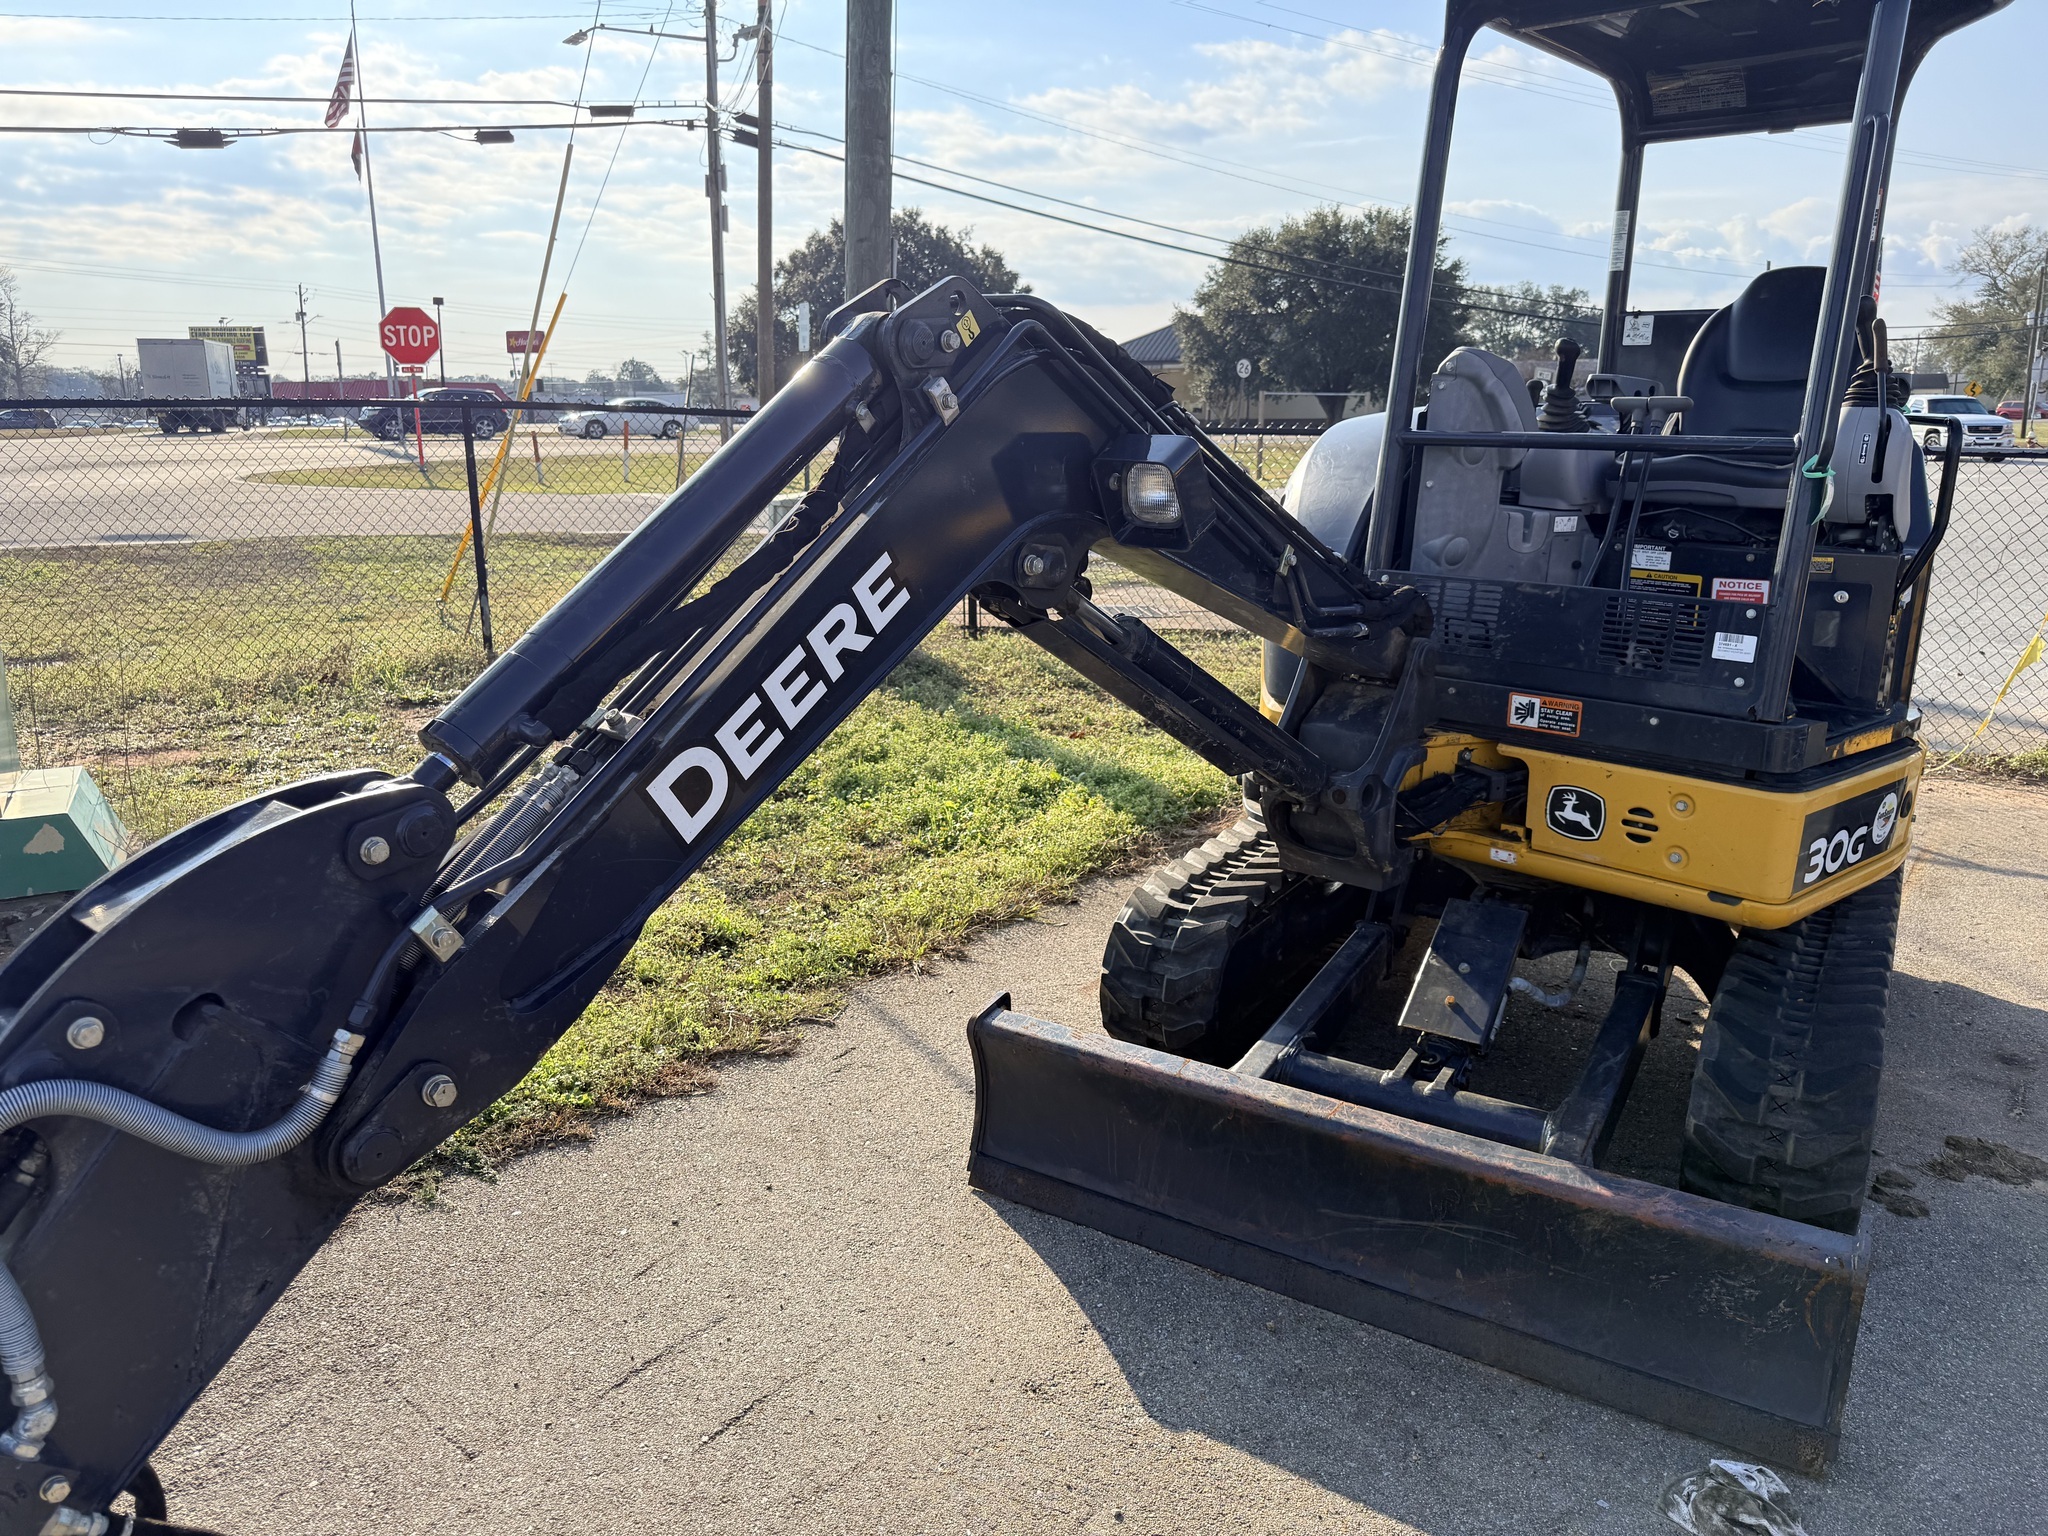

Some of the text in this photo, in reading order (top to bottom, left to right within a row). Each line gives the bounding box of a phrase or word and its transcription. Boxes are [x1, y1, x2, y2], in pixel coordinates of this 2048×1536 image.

[383, 324, 436, 347] STOP
[1238, 362, 1250, 375] 26
[1719, 580, 1763, 590] NOTICE
[646, 551, 911, 845] DEERE
[1548, 701, 1579, 710] WARNING
[1803, 826, 1868, 883] 30G
